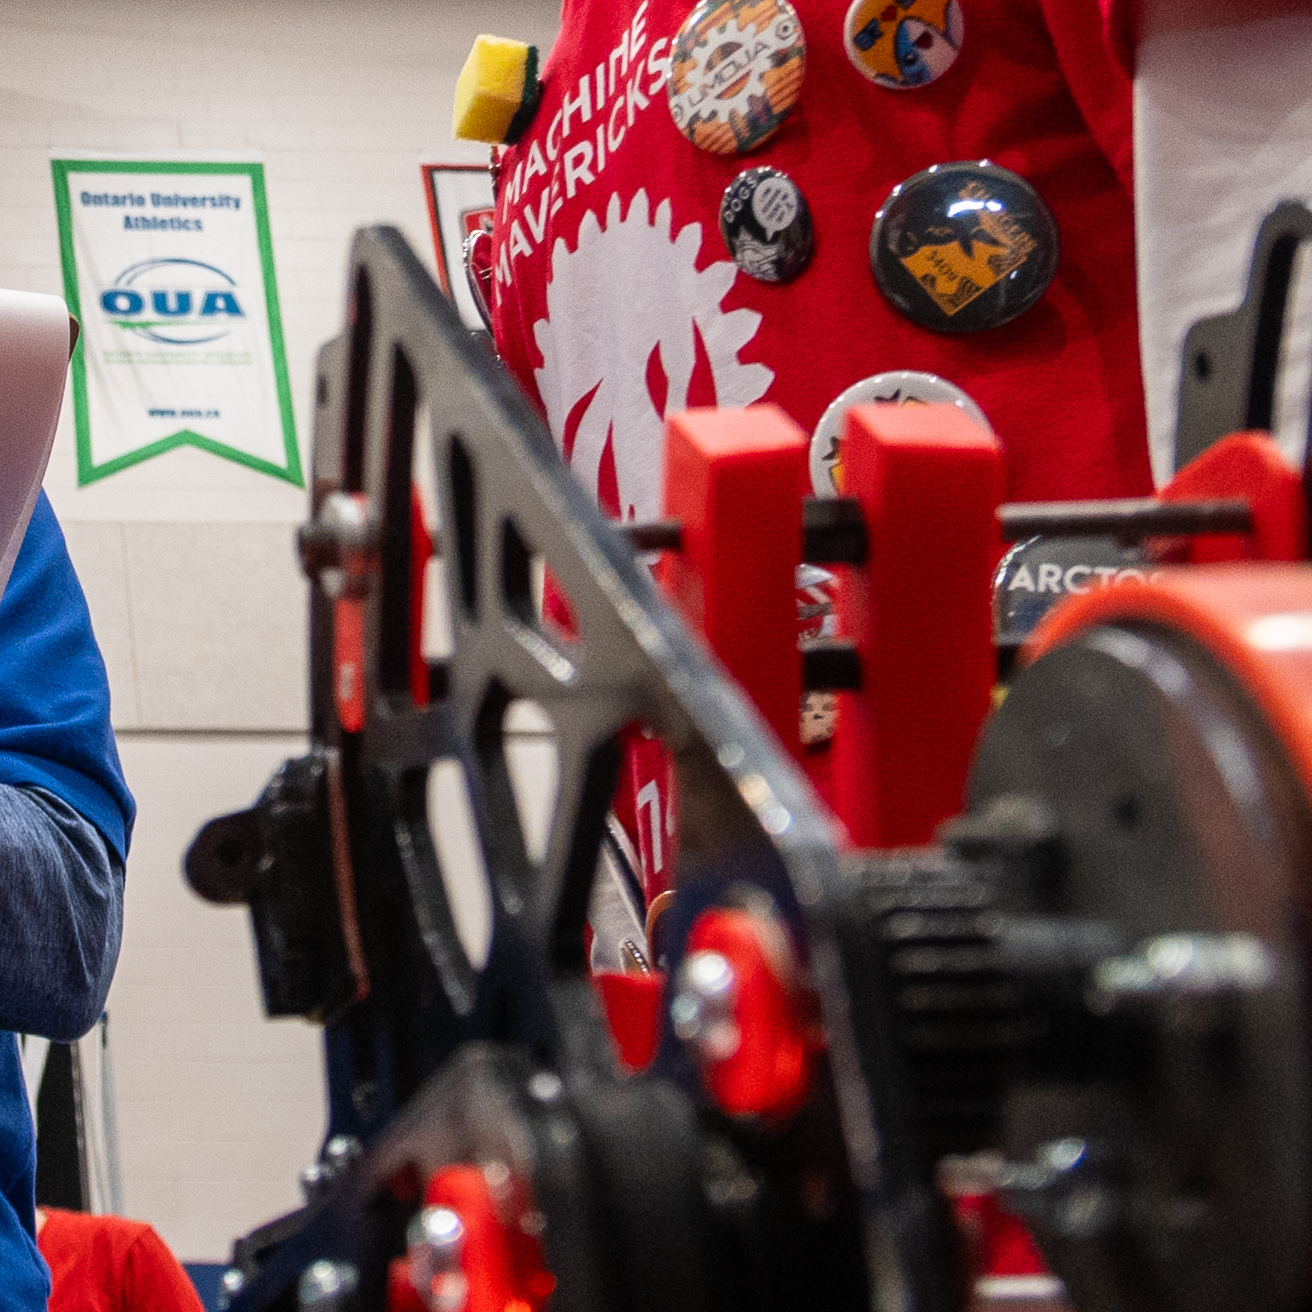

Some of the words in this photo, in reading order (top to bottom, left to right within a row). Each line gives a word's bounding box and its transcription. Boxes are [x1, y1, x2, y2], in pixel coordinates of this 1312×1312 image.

[495, 37, 674, 307] MAVERICKS
[80, 191, 146, 207] Ontario
[150, 192, 243, 211] University
[123, 214, 204, 232] Athletics
[100, 288, 245, 318] OUA
